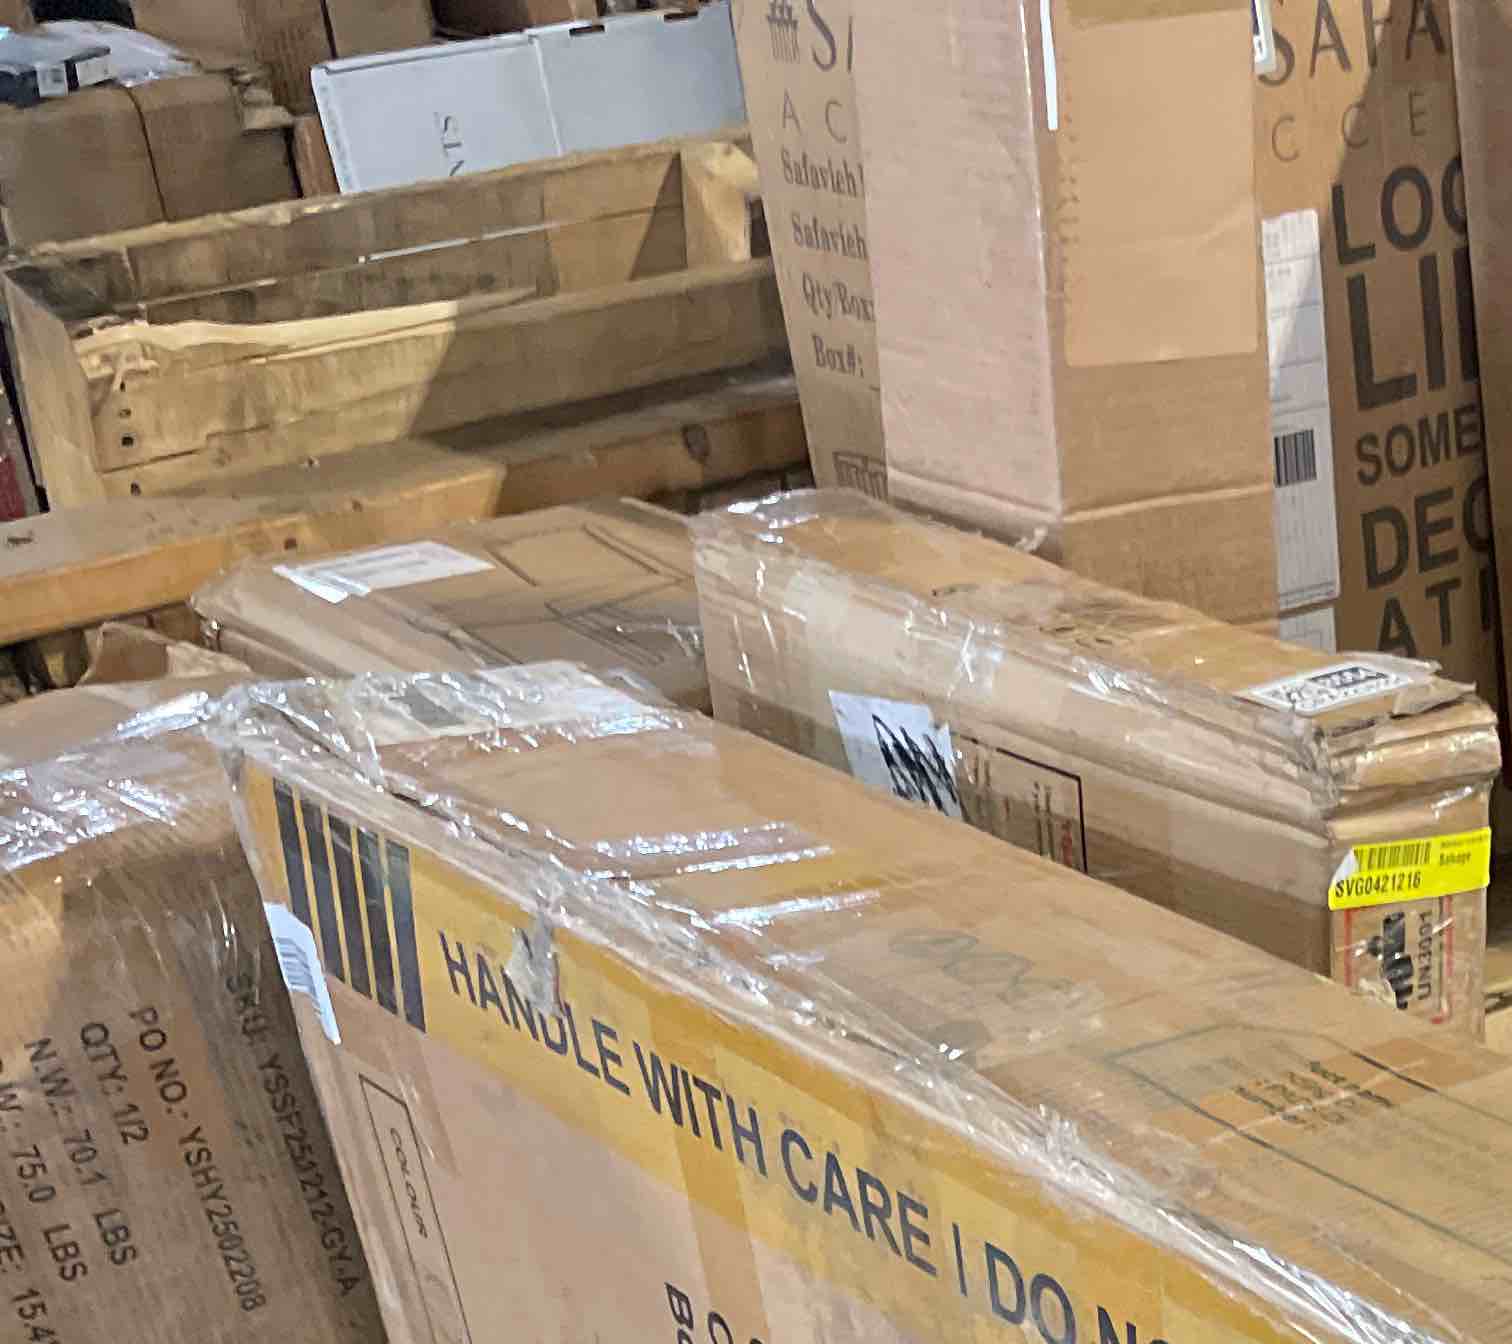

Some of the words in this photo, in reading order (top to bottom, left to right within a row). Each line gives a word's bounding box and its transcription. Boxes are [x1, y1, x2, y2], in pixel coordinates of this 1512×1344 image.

[1357, 404, 1485, 487] SOME
[80, 1021, 128, 1096] QTY:
[111, 1103, 150, 1145] 1/2
[128, 1006, 168, 1052] PO
[439, 931, 632, 1095] HANDLE
[632, 1040, 768, 1176] WITH
[781, 1128, 938, 1278] CARE
[11, 1144, 57, 1204] 75.0
[42, 1223, 88, 1283] LBS
[64, 1128, 109, 1186] 70.1
[93, 1207, 137, 1266] LBS
